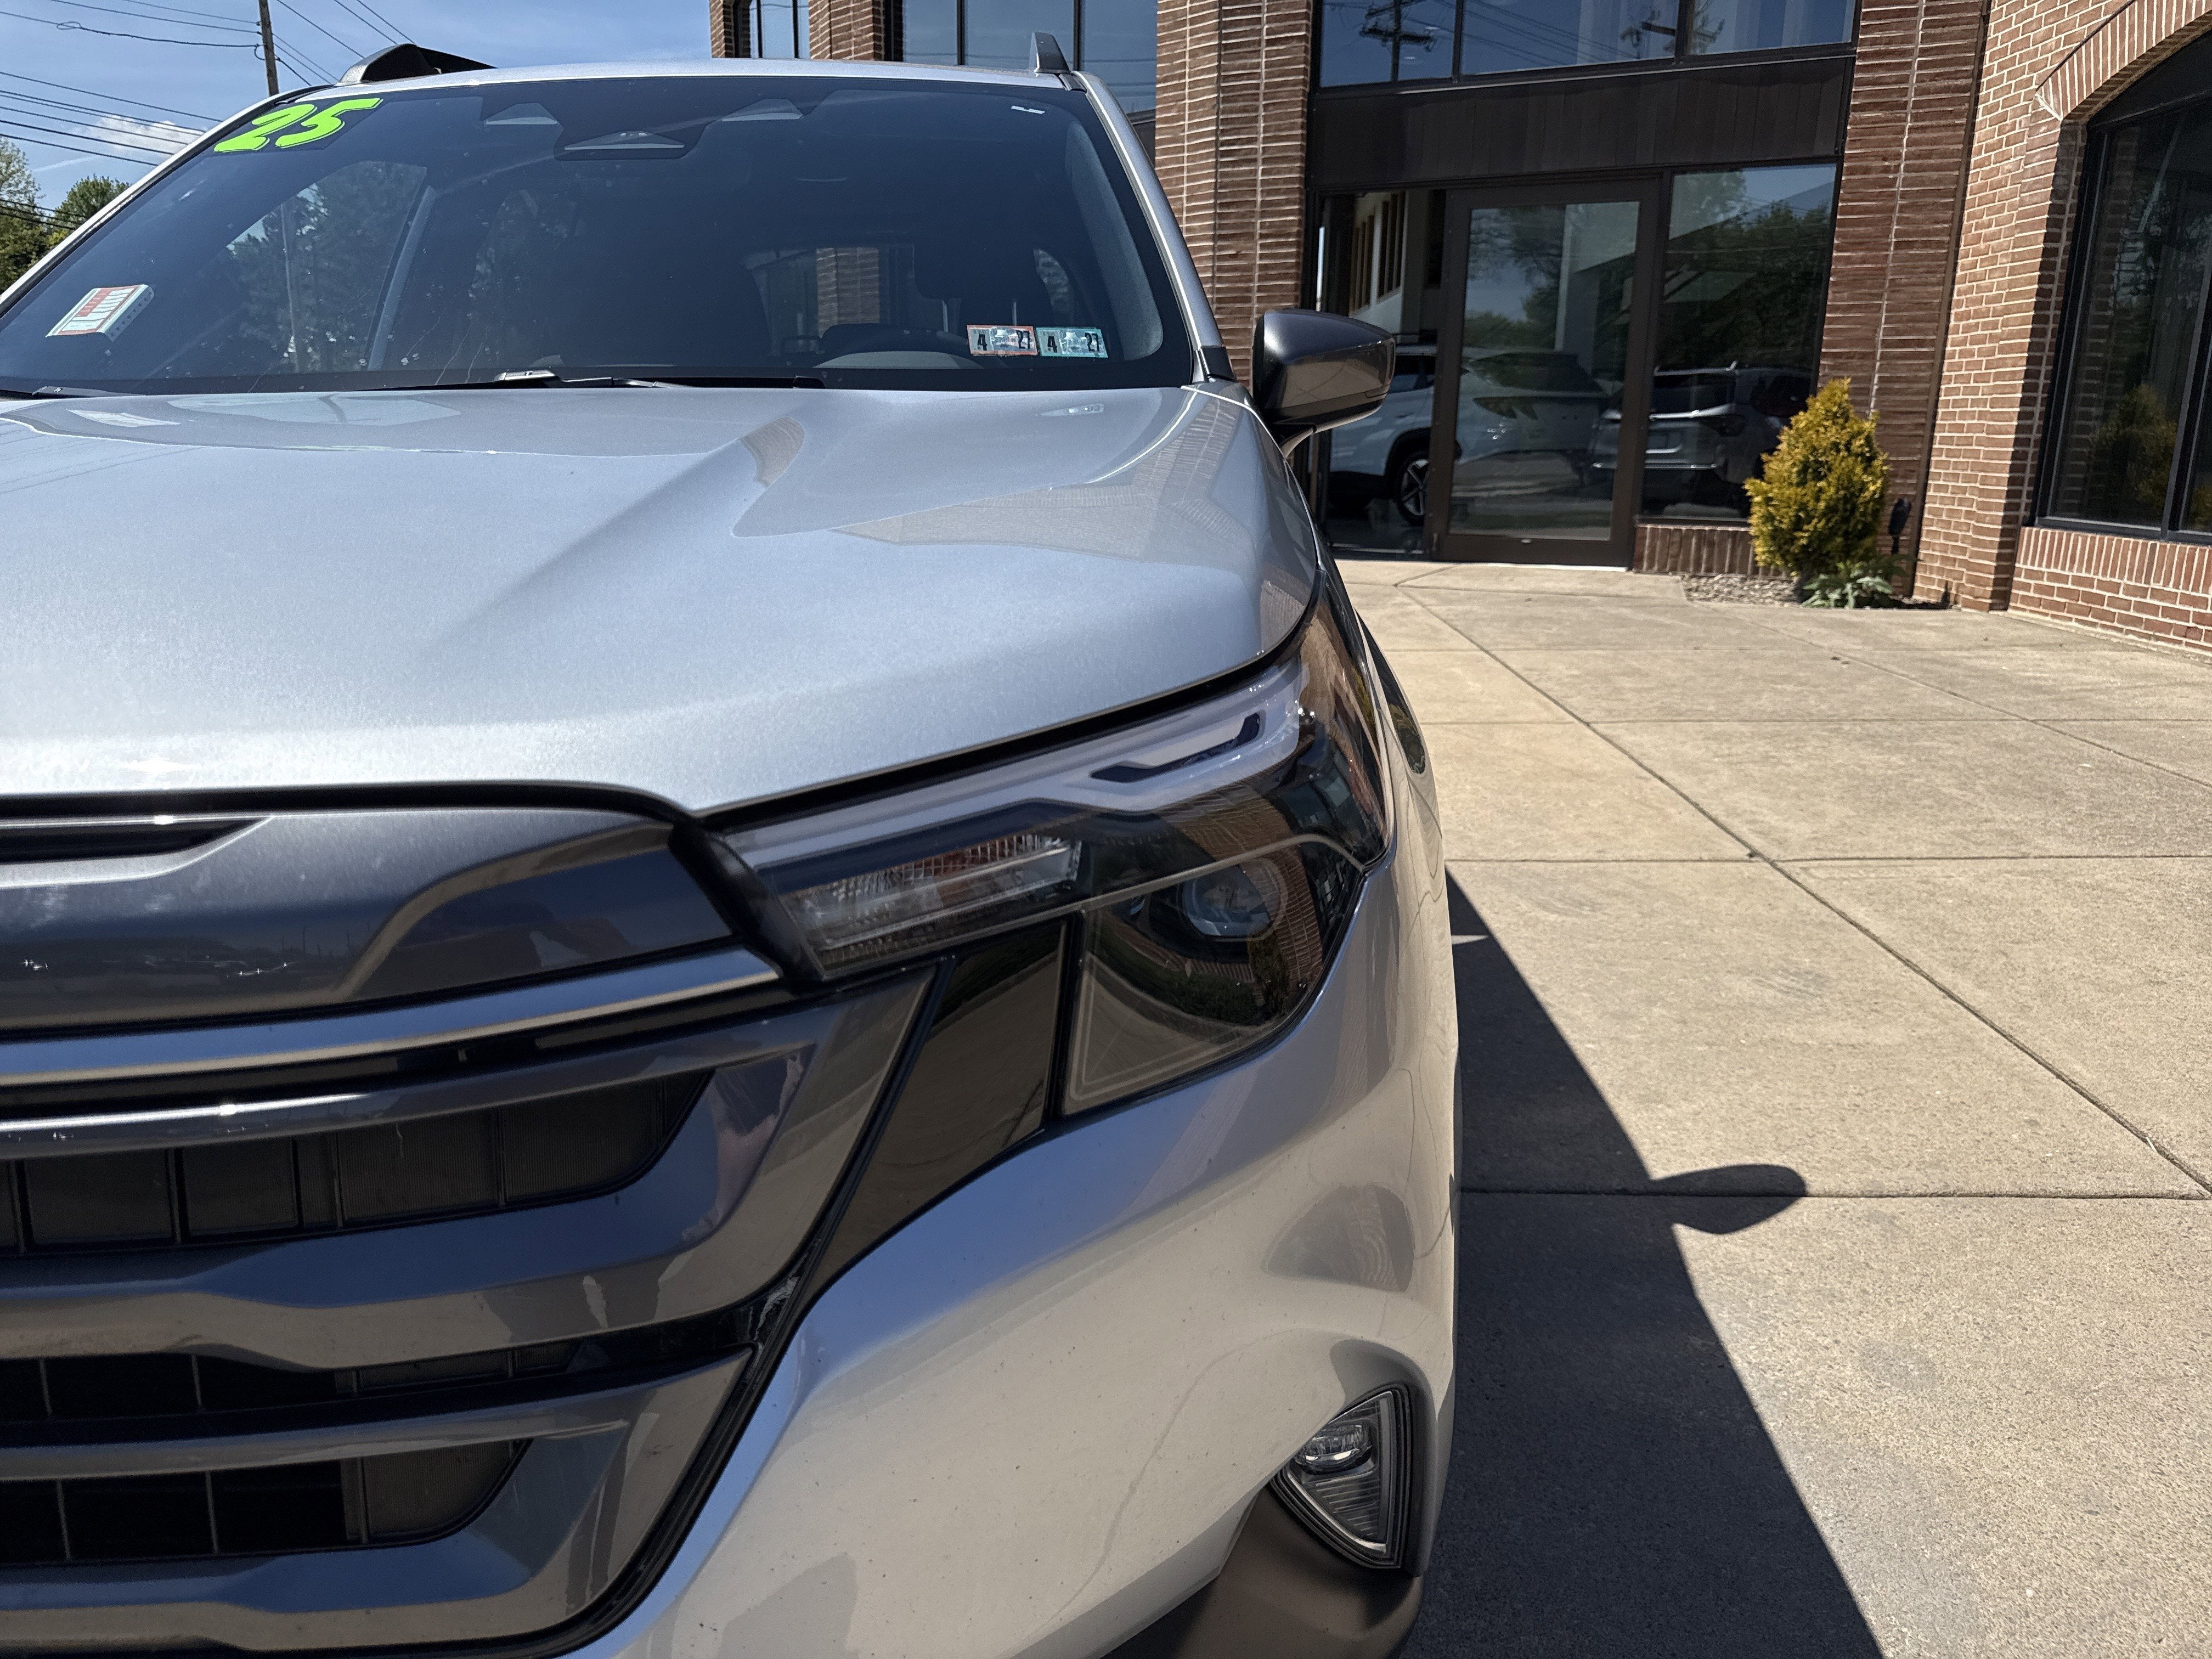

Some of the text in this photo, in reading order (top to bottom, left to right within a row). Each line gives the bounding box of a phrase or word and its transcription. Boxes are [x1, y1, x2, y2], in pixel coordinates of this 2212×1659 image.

[213, 98, 383, 153] 25
[977, 330, 1031, 351] 4 27
[1047, 332, 1100, 353] 4 27
